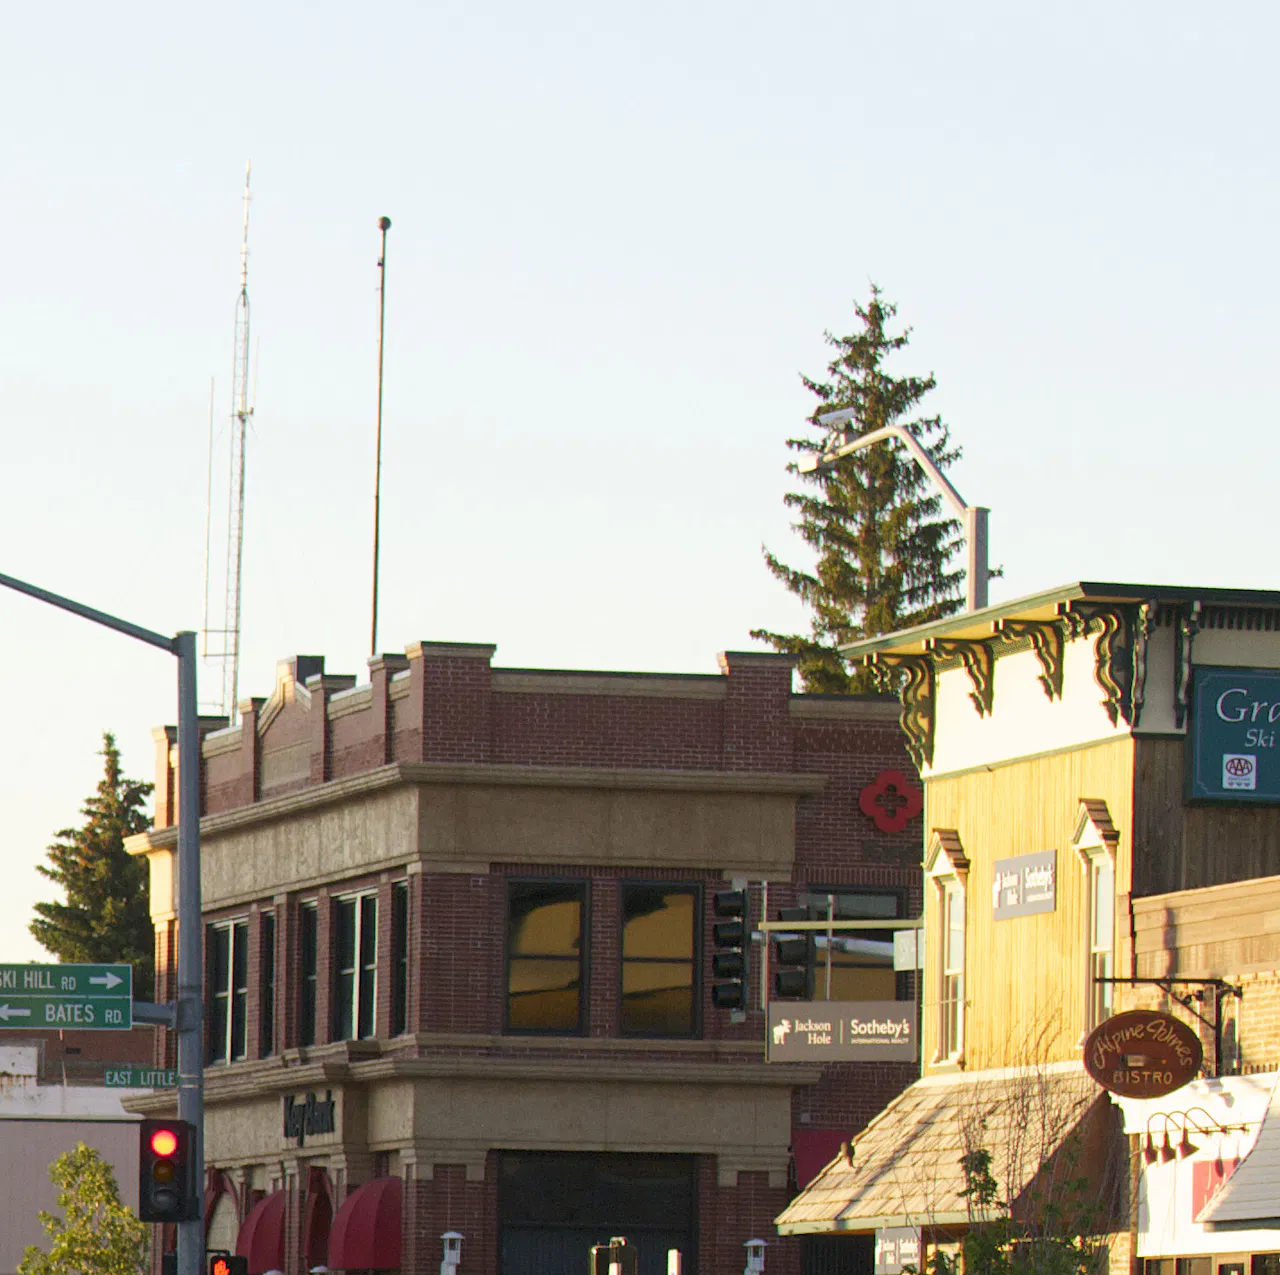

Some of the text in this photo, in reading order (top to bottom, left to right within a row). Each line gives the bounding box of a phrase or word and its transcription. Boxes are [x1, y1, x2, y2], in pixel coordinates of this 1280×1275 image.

[1244, 728, 1277, 748] Ski
[24, 971, 56, 990] HILL
[60, 976, 77, 991] RD
[45, 1003, 95, 1023] BATES
[794, 1019, 832, 1033] Jackson
[850, 1018, 911, 1038] Sotheby's
[807, 1033, 832, 1045] Hole
[1093, 1024, 1145, 1070] Alpine
[105, 1071, 176, 1086] EAST LITTLE
[1113, 1070, 1174, 1085] BISTRO
